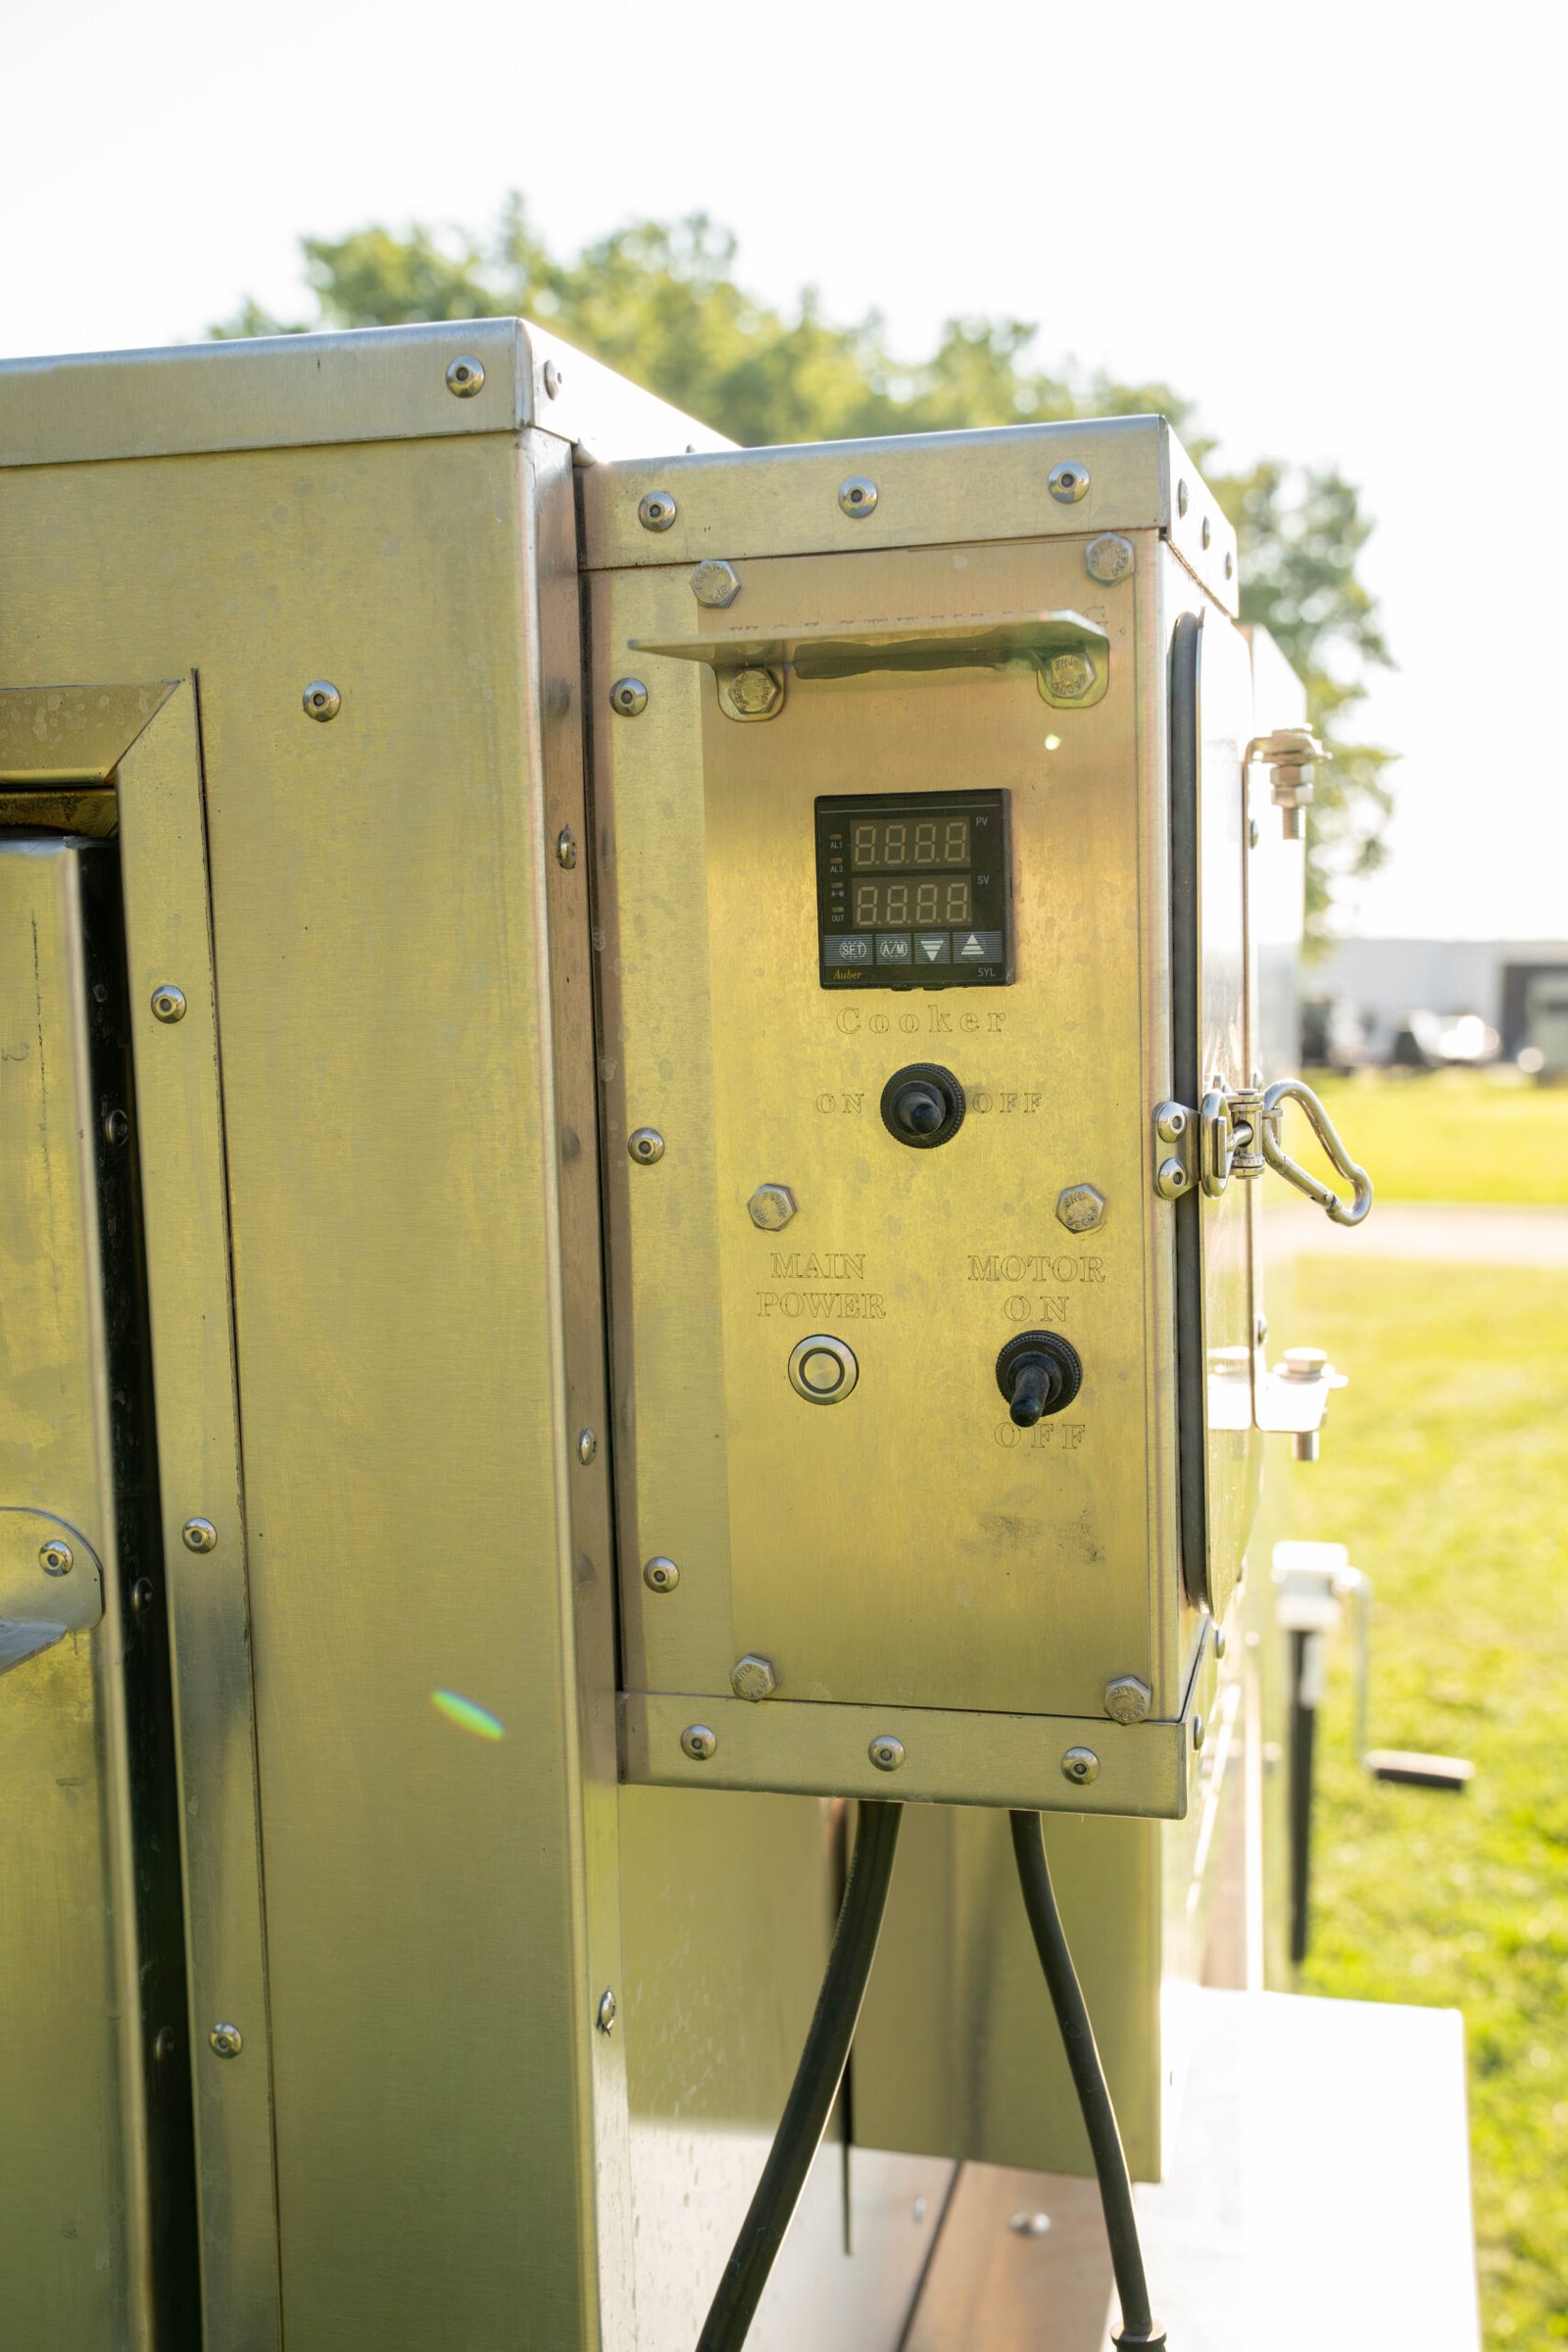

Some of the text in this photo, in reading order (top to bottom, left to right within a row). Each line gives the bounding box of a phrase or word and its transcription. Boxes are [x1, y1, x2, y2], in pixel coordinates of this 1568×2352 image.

[975, 816, 988, 827] PV
[978, 874, 990, 884] SV
[841, 945, 863, 956] SET
[882, 944, 904, 956] A/M
[833, 969, 862, 980] Auber
[978, 967, 996, 977] SYL
[836, 1004, 1006, 1035] Cooker
[815, 1093, 864, 1114] ON
[972, 1092, 1043, 1114] OFF
[770, 1252, 866, 1280] MAIN
[967, 1254, 1106, 1283] MOTOR
[756, 1291, 887, 1319] POWER
[1004, 1295, 1070, 1323] ON
[994, 1421, 1086, 1450] OFF
